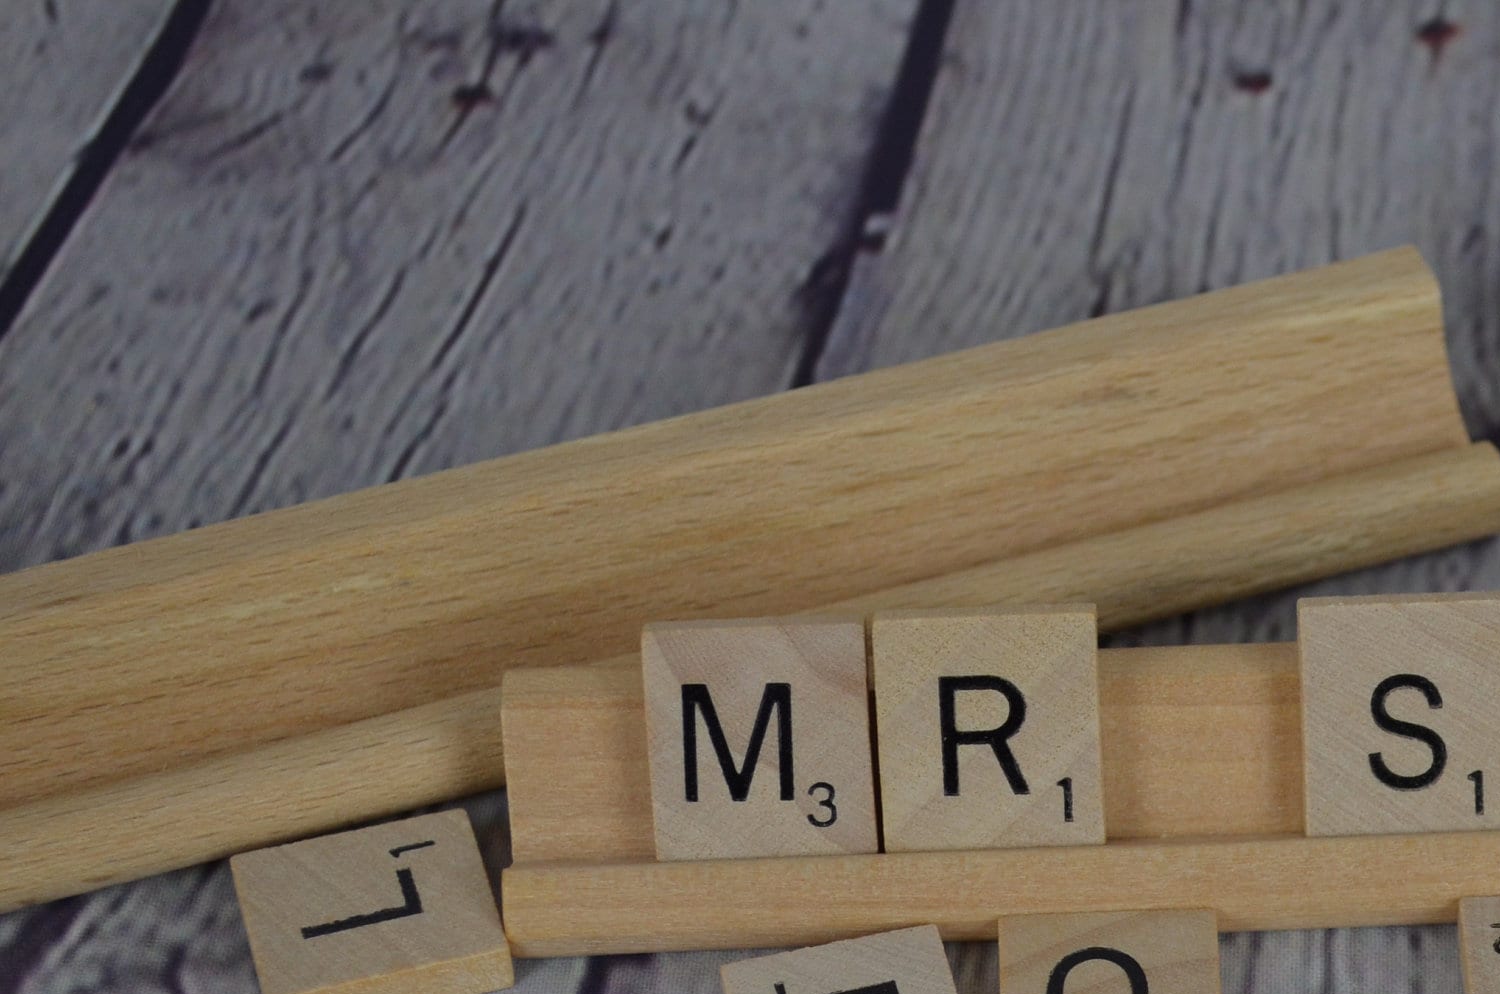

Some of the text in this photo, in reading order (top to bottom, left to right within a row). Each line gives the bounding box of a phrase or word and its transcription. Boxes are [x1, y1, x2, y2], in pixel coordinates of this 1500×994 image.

[807, 782, 837, 827] 3
[1057, 777, 1073, 822] 1
[1468, 770, 1484, 814] 1
[301, 868, 423, 939] L
